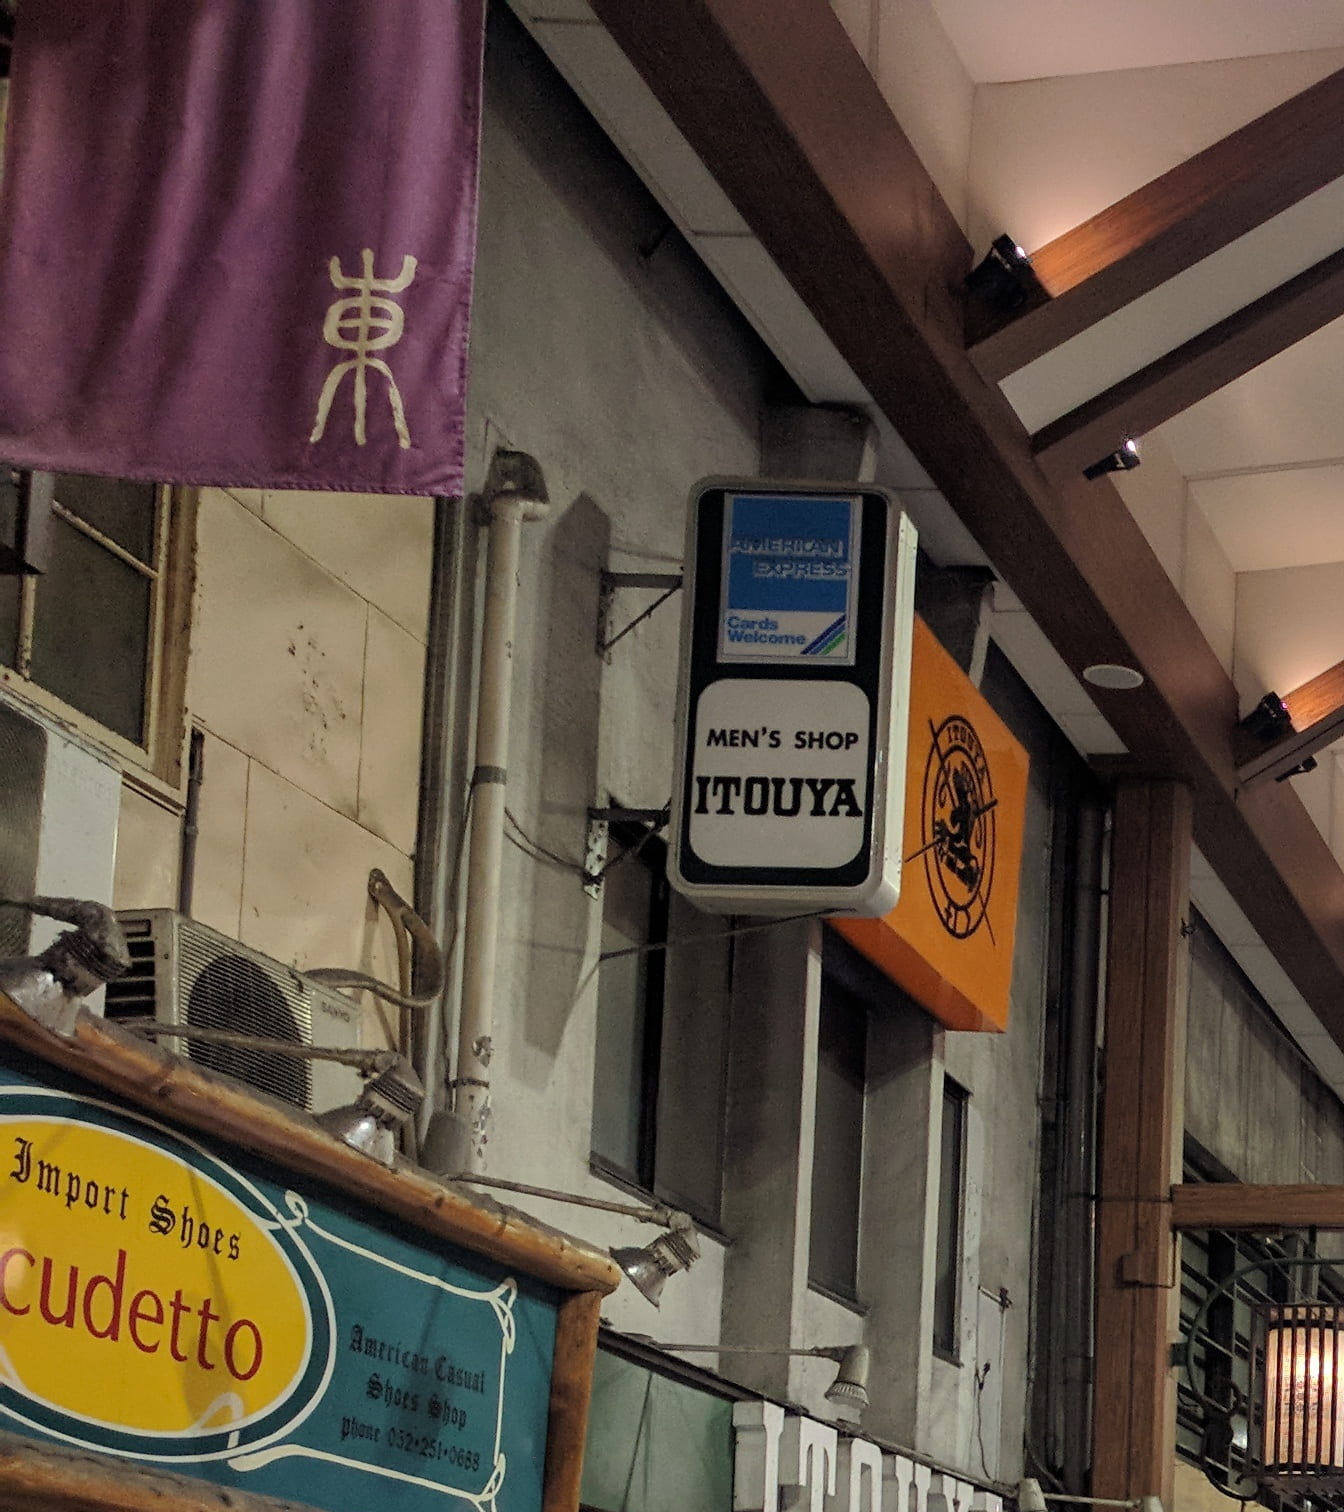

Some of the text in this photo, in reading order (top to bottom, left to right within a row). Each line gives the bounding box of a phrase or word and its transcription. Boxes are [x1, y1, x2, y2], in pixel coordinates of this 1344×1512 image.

[727, 536, 844, 558] AMERICAN
[752, 558, 850, 580] EXPRESS
[726, 613, 779, 631] Cards
[726, 627, 807, 648] Welcome
[706, 727, 860, 751] MEN'S SHOP
[693, 775, 863, 818] ITOUYA
[10, 1136, 242, 1262] Import Shoes
[350, 1323, 486, 1395] American Casual
[366, 1372, 467, 1431] Shoes Shop
